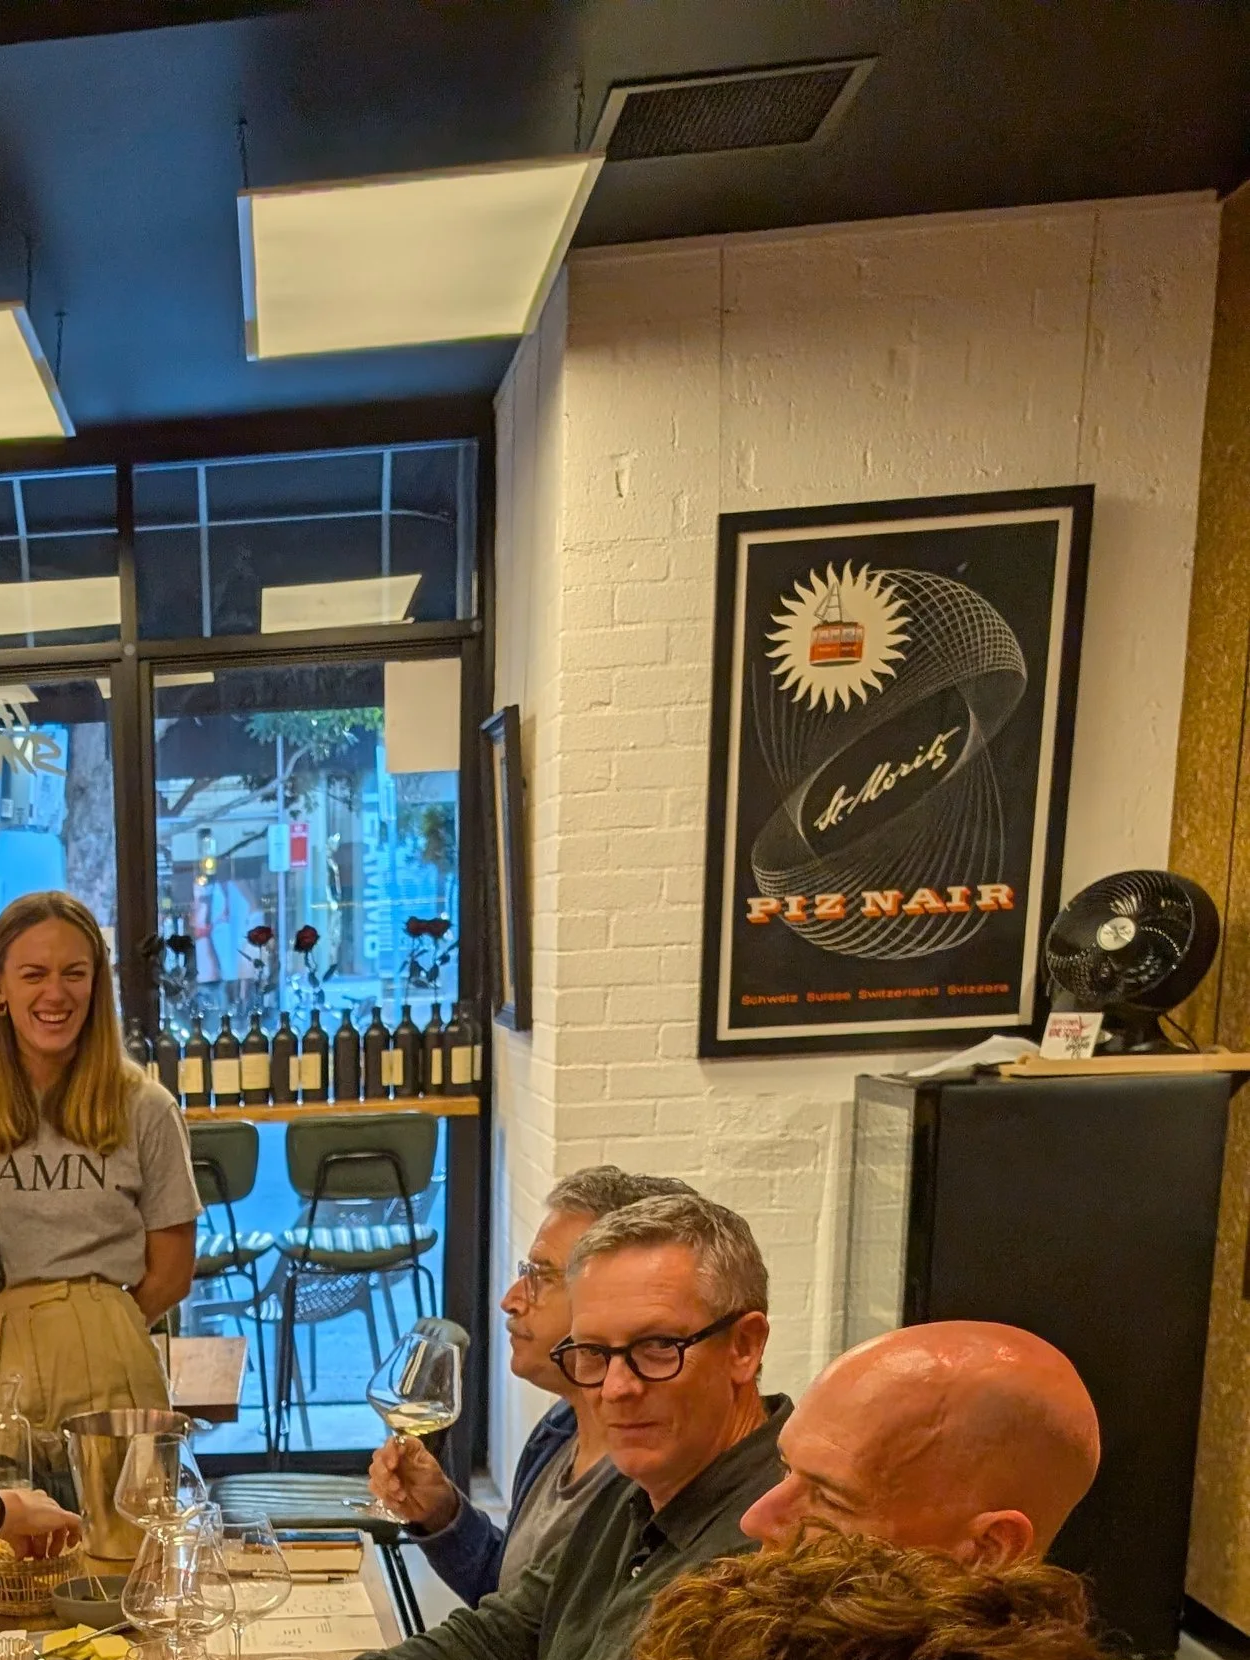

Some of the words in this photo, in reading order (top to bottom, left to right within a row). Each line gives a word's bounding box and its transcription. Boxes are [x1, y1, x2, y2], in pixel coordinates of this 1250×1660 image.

[846, 726, 961, 814] Moritz
[746, 893, 847, 923] PIZ
[860, 884, 1014, 917] NAIR
[741, 993, 799, 1006] Schweiz
[806, 990, 851, 1003] Suisse
[858, 986, 940, 1000] Switzerland
[947, 983, 1010, 996] Svizzera
